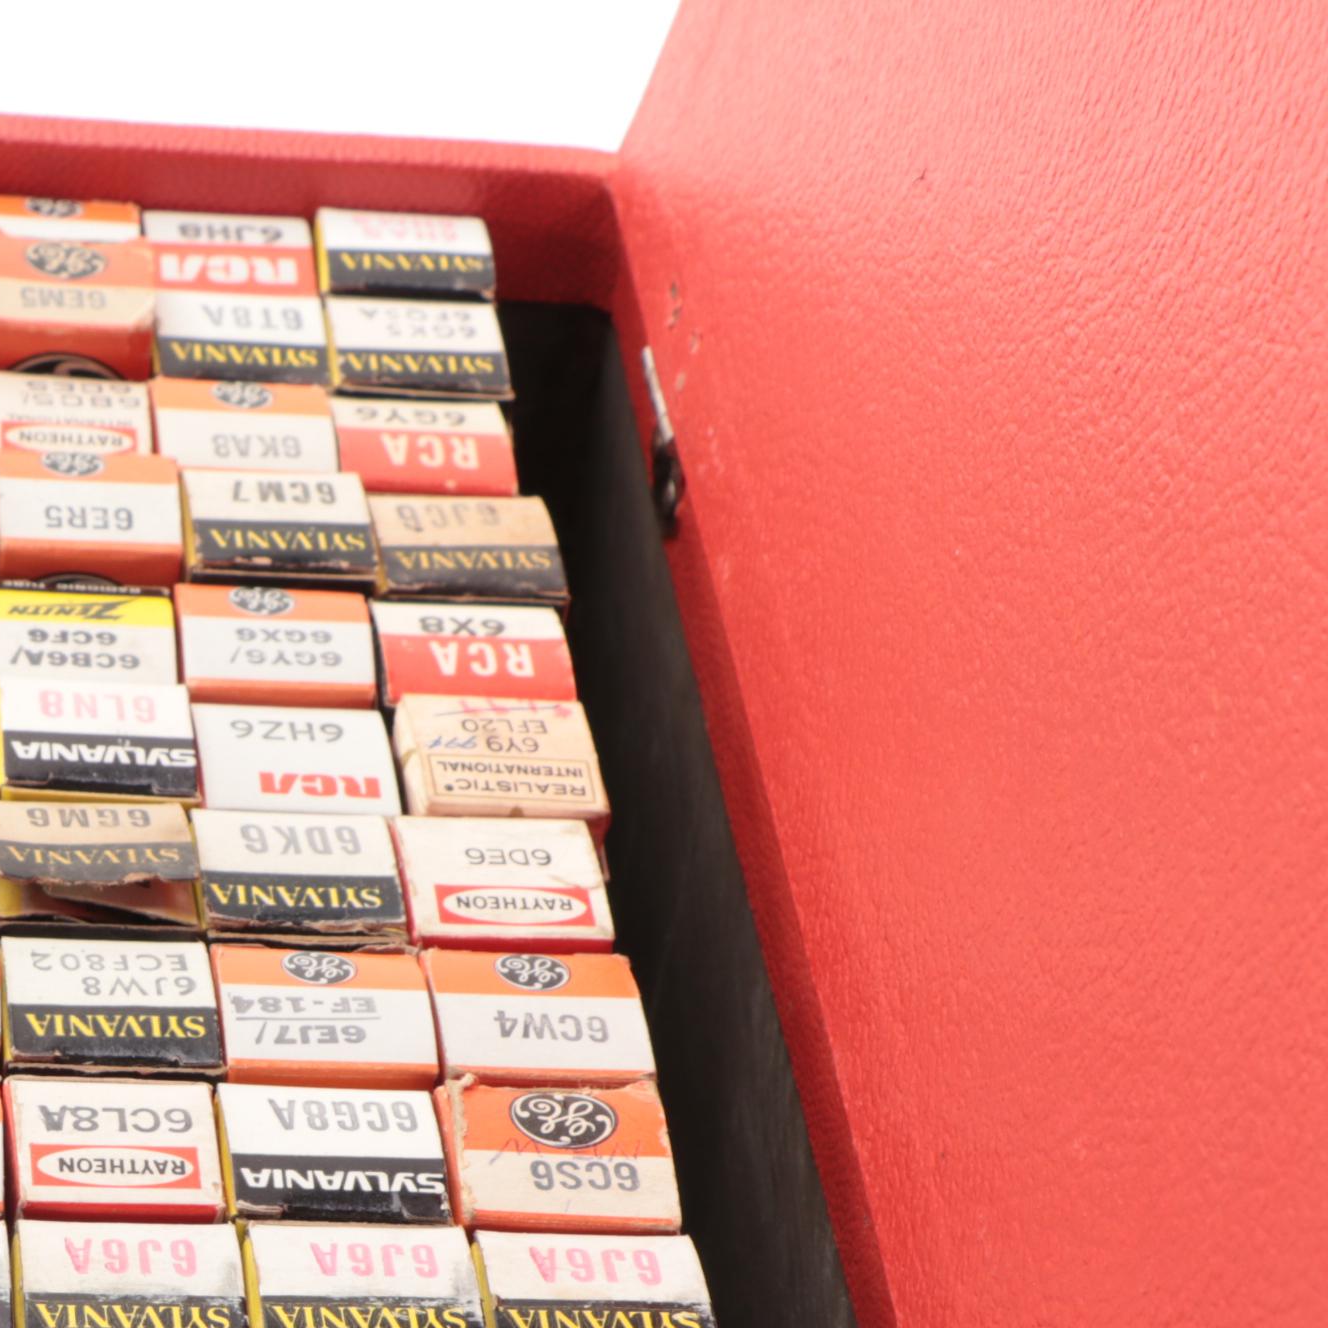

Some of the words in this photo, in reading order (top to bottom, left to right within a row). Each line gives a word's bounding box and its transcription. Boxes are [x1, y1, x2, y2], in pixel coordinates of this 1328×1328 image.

[159, 253, 299, 286] RCA
[339, 251, 484, 273] SYLVANIA
[169, 341, 320, 368] SYLVANIA
[345, 352, 496, 376] SYLVANIA
[19, 429, 124, 447] RAYTHEON
[379, 432, 481, 469] RCA
[231, 480, 336, 505] 6CM7
[43, 505, 134, 531] 6ER5
[207, 527, 367, 553] SYLVANIA
[394, 548, 552, 572] SYLVANIA
[6, 601, 133, 622] ZENITH
[27, 629, 118, 647] 6CF6
[418, 615, 506, 636] 6X8
[9, 646, 141, 669] 6CB6A/
[428, 641, 536, 678] RCA
[229, 719, 344, 743] 6HZ6
[9, 739, 197, 768] SYLVANIA
[486, 735, 539, 754] 6Y9
[436, 760, 584, 778] INTERNATIONAL
[258, 771, 383, 799] RCA
[25, 806, 152, 829] 6GM6
[239, 824, 363, 857] 6DK6
[5, 845, 181, 868] SYLVANIA
[463, 847, 552, 867] 6DE6
[209, 881, 384, 909] SYLVANIA
[454, 894, 573, 912] RAYTHEON
[30, 950, 190, 973] ECF802
[80, 975, 199, 997] 6JW8
[24, 1011, 207, 1039] SYLVANIA
[254, 1020, 367, 1045] 6EJ7/
[493, 1010, 610, 1044] 6CW4
[37, 1103, 195, 1134] 6CL8A
[266, 1097, 420, 1134] 6CG8A
[57, 1156, 188, 1176] RAYTHEON
[529, 1160, 641, 1192] 6CS6
[240, 1167, 445, 1195] SYLVANIA
[308, 1242, 441, 1279] 6J6A
[528, 1246, 664, 1286] 6J6A
